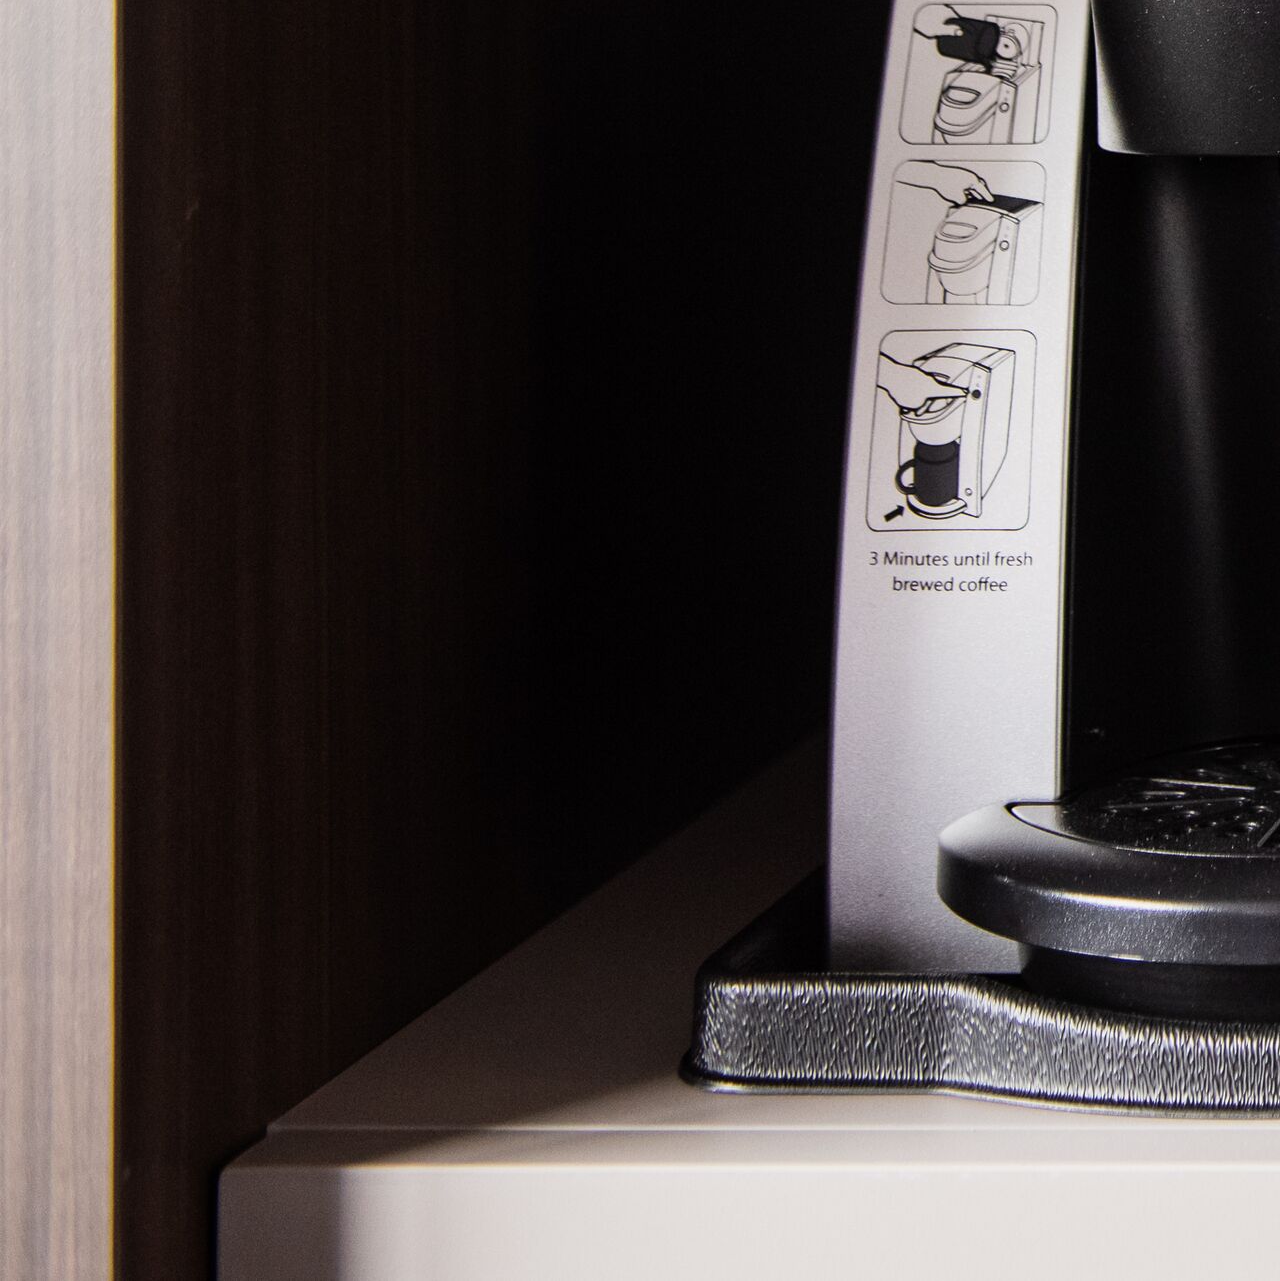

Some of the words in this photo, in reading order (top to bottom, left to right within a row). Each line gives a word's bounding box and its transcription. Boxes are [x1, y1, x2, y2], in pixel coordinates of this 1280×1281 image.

[869, 551, 878, 566] 3
[883, 551, 949, 566] Minutes
[954, 551, 990, 566] until
[994, 551, 1033, 566] fresh
[892, 576, 954, 592] brewed
[959, 576, 1008, 592] coffee
